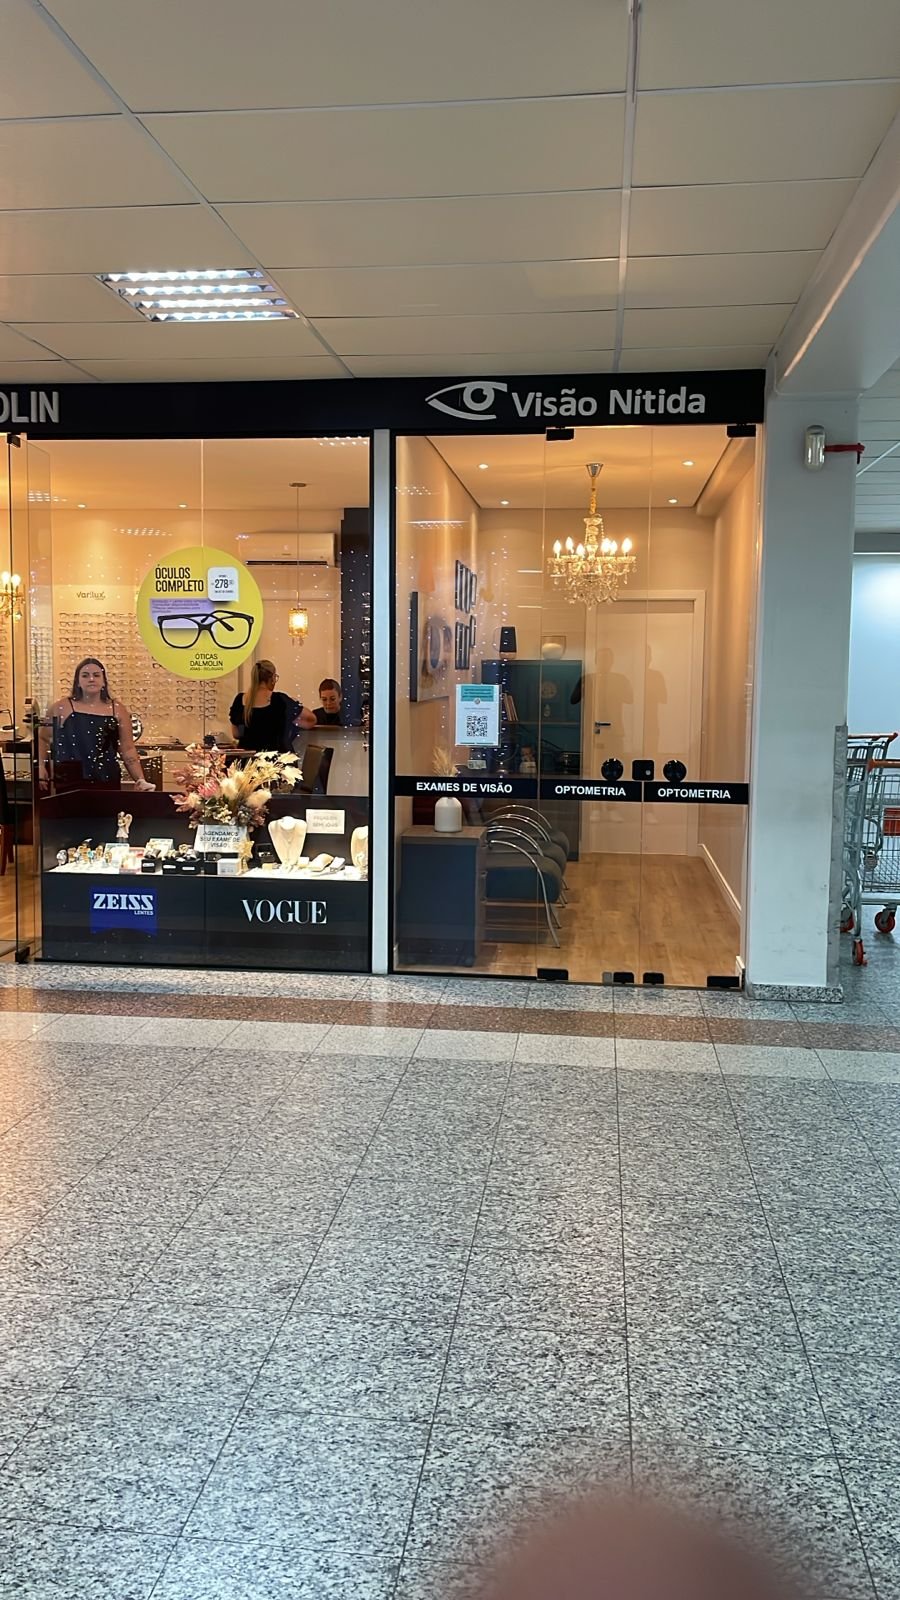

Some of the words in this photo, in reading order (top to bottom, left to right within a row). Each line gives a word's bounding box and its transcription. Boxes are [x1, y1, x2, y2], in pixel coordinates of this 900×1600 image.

[512, 388, 597, 418] Visão
[155, 564, 191, 580] ÓCULOS
[155, 580, 204, 592] COMPLETO
[214, 579, 229, 588] 278
[416, 782, 460, 792] EXAMES
[462, 783, 477, 793] DE
[479, 782, 513, 794] VISÃO
[554, 785, 627, 797] OPTOMETRIA
[657, 788, 731, 799] OPTOMETRIA
[93, 893, 154, 911] ZEISS
[241, 899, 327, 924] VOGUE
